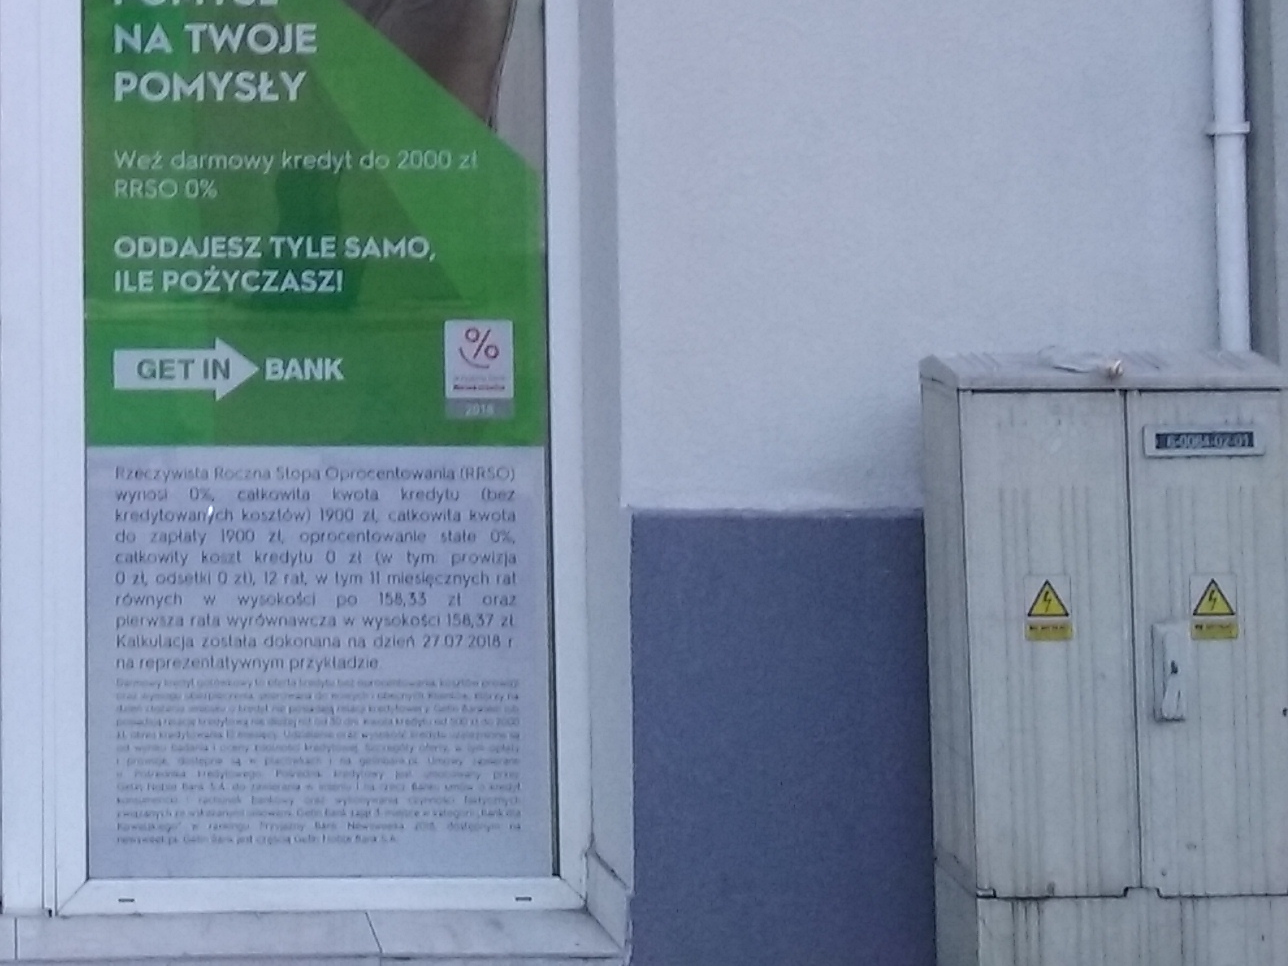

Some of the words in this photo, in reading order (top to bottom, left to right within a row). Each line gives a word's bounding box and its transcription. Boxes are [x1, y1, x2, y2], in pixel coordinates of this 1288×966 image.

[114, 23, 173, 54] NA
[185, 23, 318, 54] TWOJE
[114, 71, 306, 102] POMYSŁY
[114, 149, 162, 169] Weź
[171, 150, 273, 174] darmowy
[281, 150, 353, 174] kredyt
[360, 150, 390, 169] do
[397, 150, 452, 169] 2000
[459, 150, 478, 169] zł
[114, 179, 178, 198] RRSO
[184, 179, 218, 199] 0%
[114, 237, 262, 259] ODDAJESZ
[269, 237, 337, 259] TYLE
[344, 237, 437, 262] SAMO,
[114, 270, 154, 292] ILE
[163, 265, 344, 293] POŻYCZASZ!
[136, 358, 197, 381] GET
[202, 358, 231, 381] IN
[264, 357, 345, 381] BANK
[213, 466, 272, 480] Roczna
[275, 466, 322, 484] Stopa
[325, 465, 457, 482] Oprocentowania
[459, 466, 516, 482] (RRSO)
[236, 487, 311, 502] całkowita
[332, 487, 380, 502] kwota
[400, 487, 460, 505] kredytu
[114, 507, 234, 526] kredytowanych
[240, 507, 311, 523] kosztów)
[319, 507, 355, 523] 1900
[387, 508, 462, 523] całkowita
[468, 509, 517, 523] kwota
[114, 529, 137, 544] do
[220, 528, 256, 543] 1900
[299, 528, 427, 546] oprocentowanie
[114, 550, 189, 567] całkowity
[200, 550, 242, 565] koszt
[253, 549, 314, 567] kredytu
[325, 549, 337, 565] 0
[374, 551, 393, 566] (w
[406, 550, 436, 568] tym
[450, 551, 518, 568] prowizja
[114, 570, 126, 586] 0
[154, 571, 212, 586] odsetki
[217, 570, 229, 586] 0
[263, 570, 278, 586] 12
[314, 573, 328, 585] w
[333, 570, 363, 588] tym
[386, 571, 490, 589] miesięcznych
[496, 571, 518, 586] rat
[114, 592, 183, 610] równych
[202, 594, 217, 606] w
[236, 591, 316, 610] wysokości
[335, 594, 358, 609] po
[378, 591, 428, 608] 158,33
[481, 594, 517, 607] oraz
[115, 615, 185, 631] pierwsza
[189, 612, 221, 628] rata
[225, 613, 337, 630] wyrównawcza
[343, 616, 356, 627] w
[361, 613, 442, 631] wysokości
[446, 612, 495, 629] 158,37
[115, 634, 196, 651] Kalkulacja
[200, 634, 257, 649] została
[262, 634, 342, 649] dokonana
[346, 636, 367, 649] na
[372, 634, 416, 649] dzień
[115, 658, 135, 670] na
[138, 654, 285, 673] reprezentatywnym
